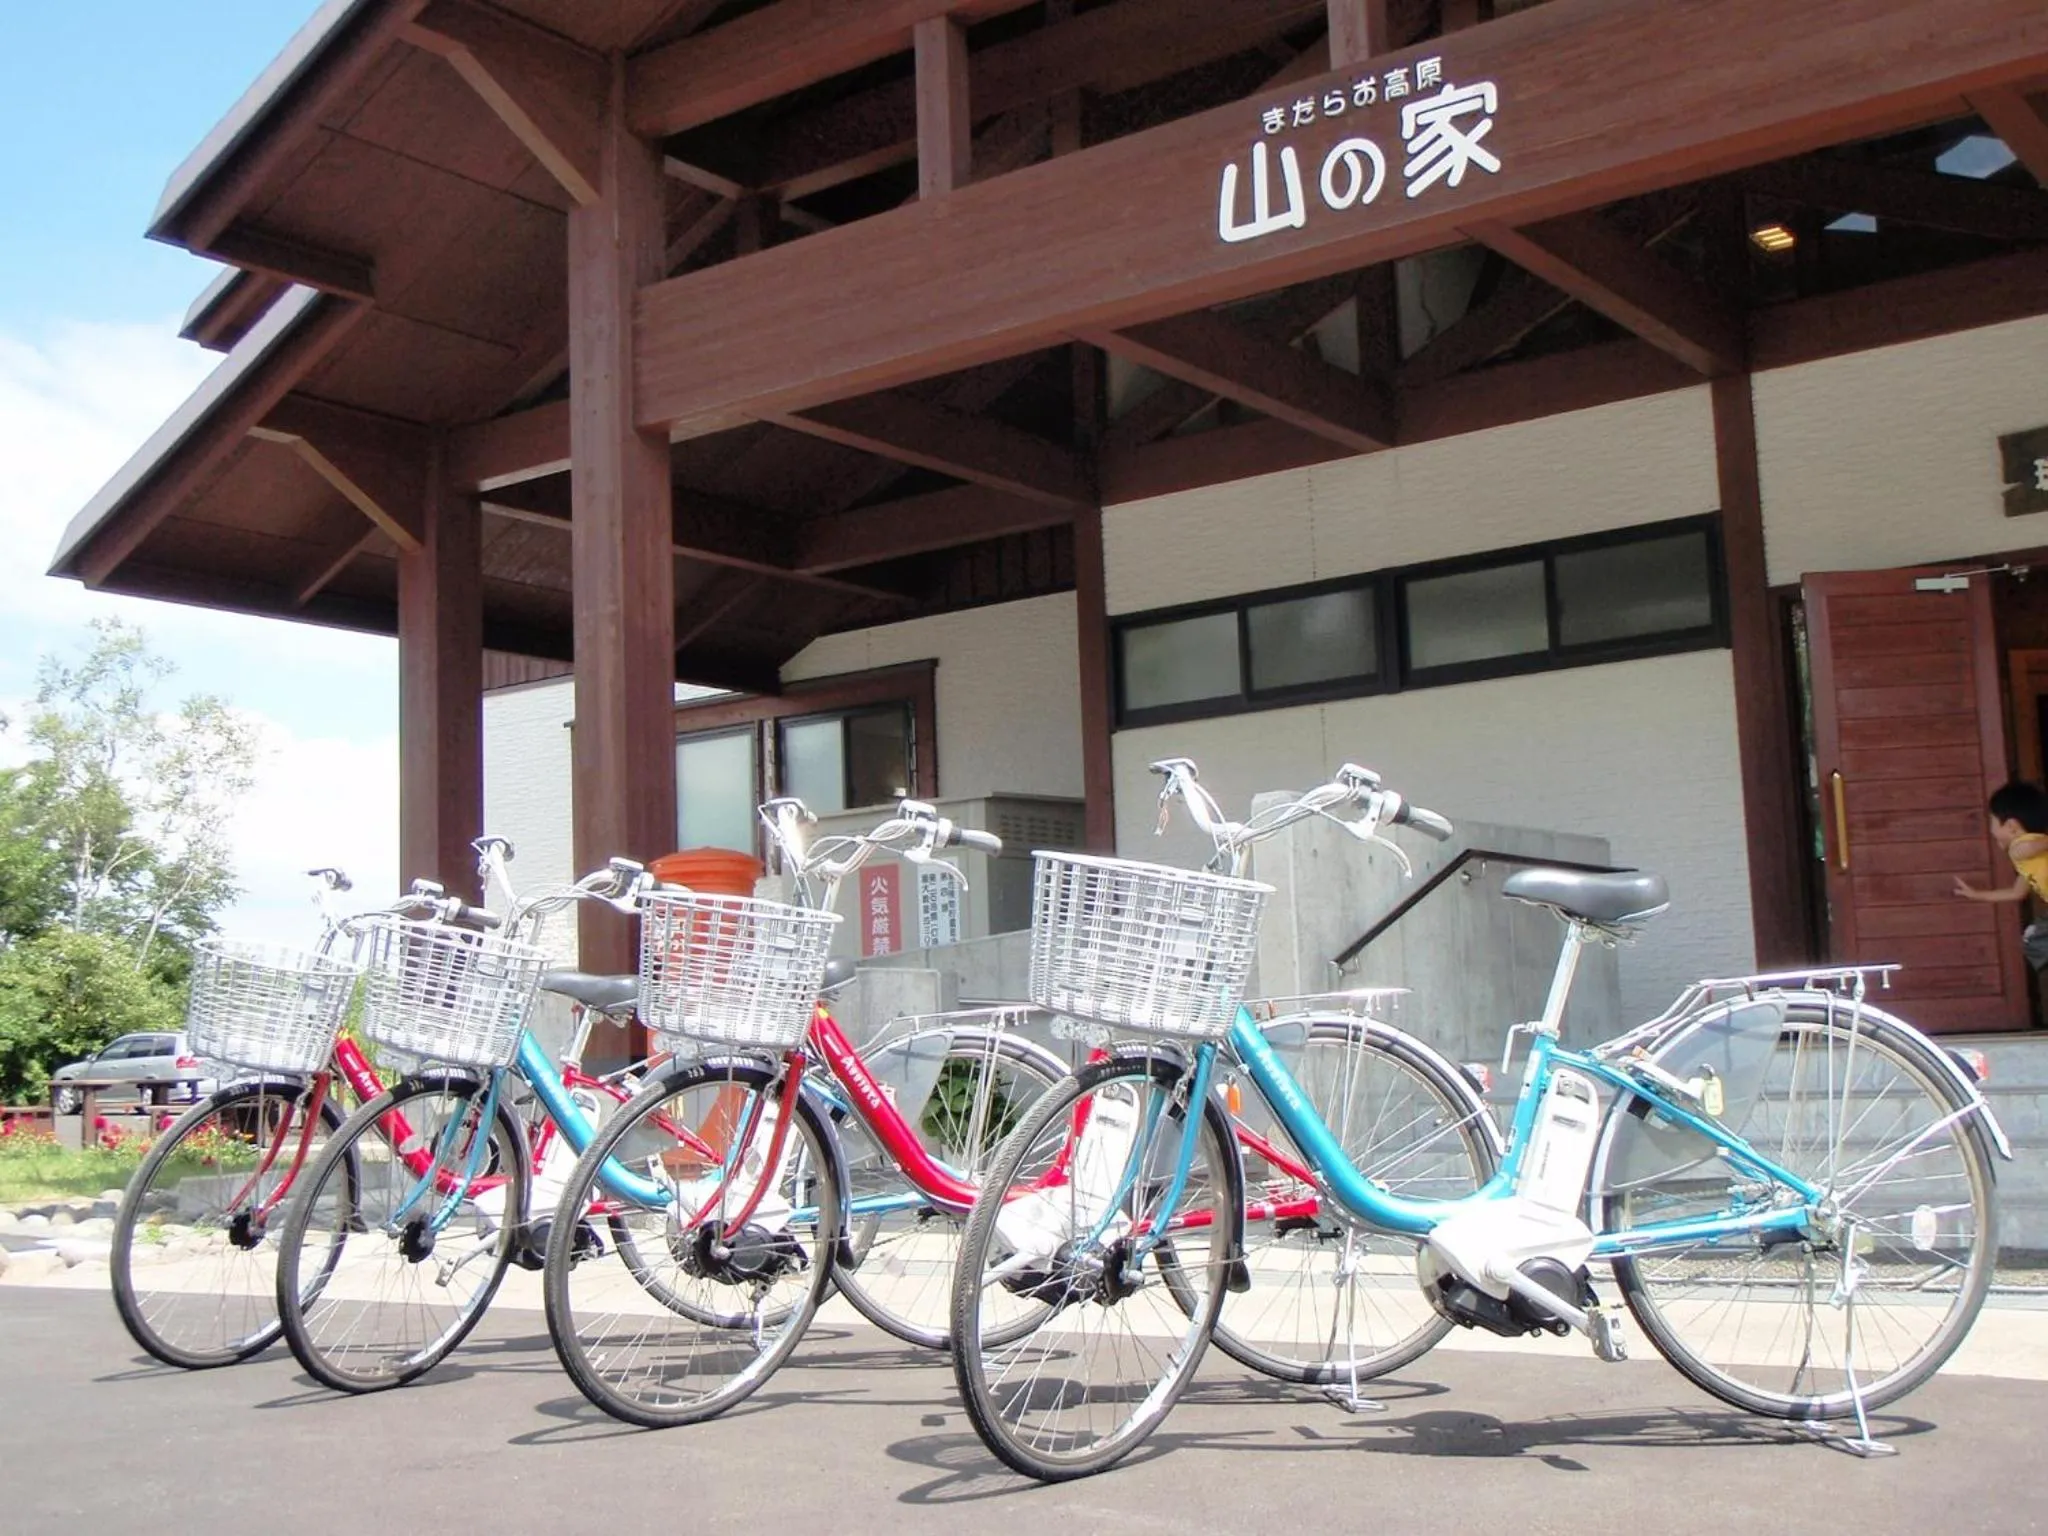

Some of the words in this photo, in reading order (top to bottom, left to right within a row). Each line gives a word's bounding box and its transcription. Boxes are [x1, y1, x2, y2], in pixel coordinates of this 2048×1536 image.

[1262, 56, 1442, 134] まだらお高原
[1219, 81, 1501, 242] 山の家
[870, 876, 891, 955] 火気厳禁
